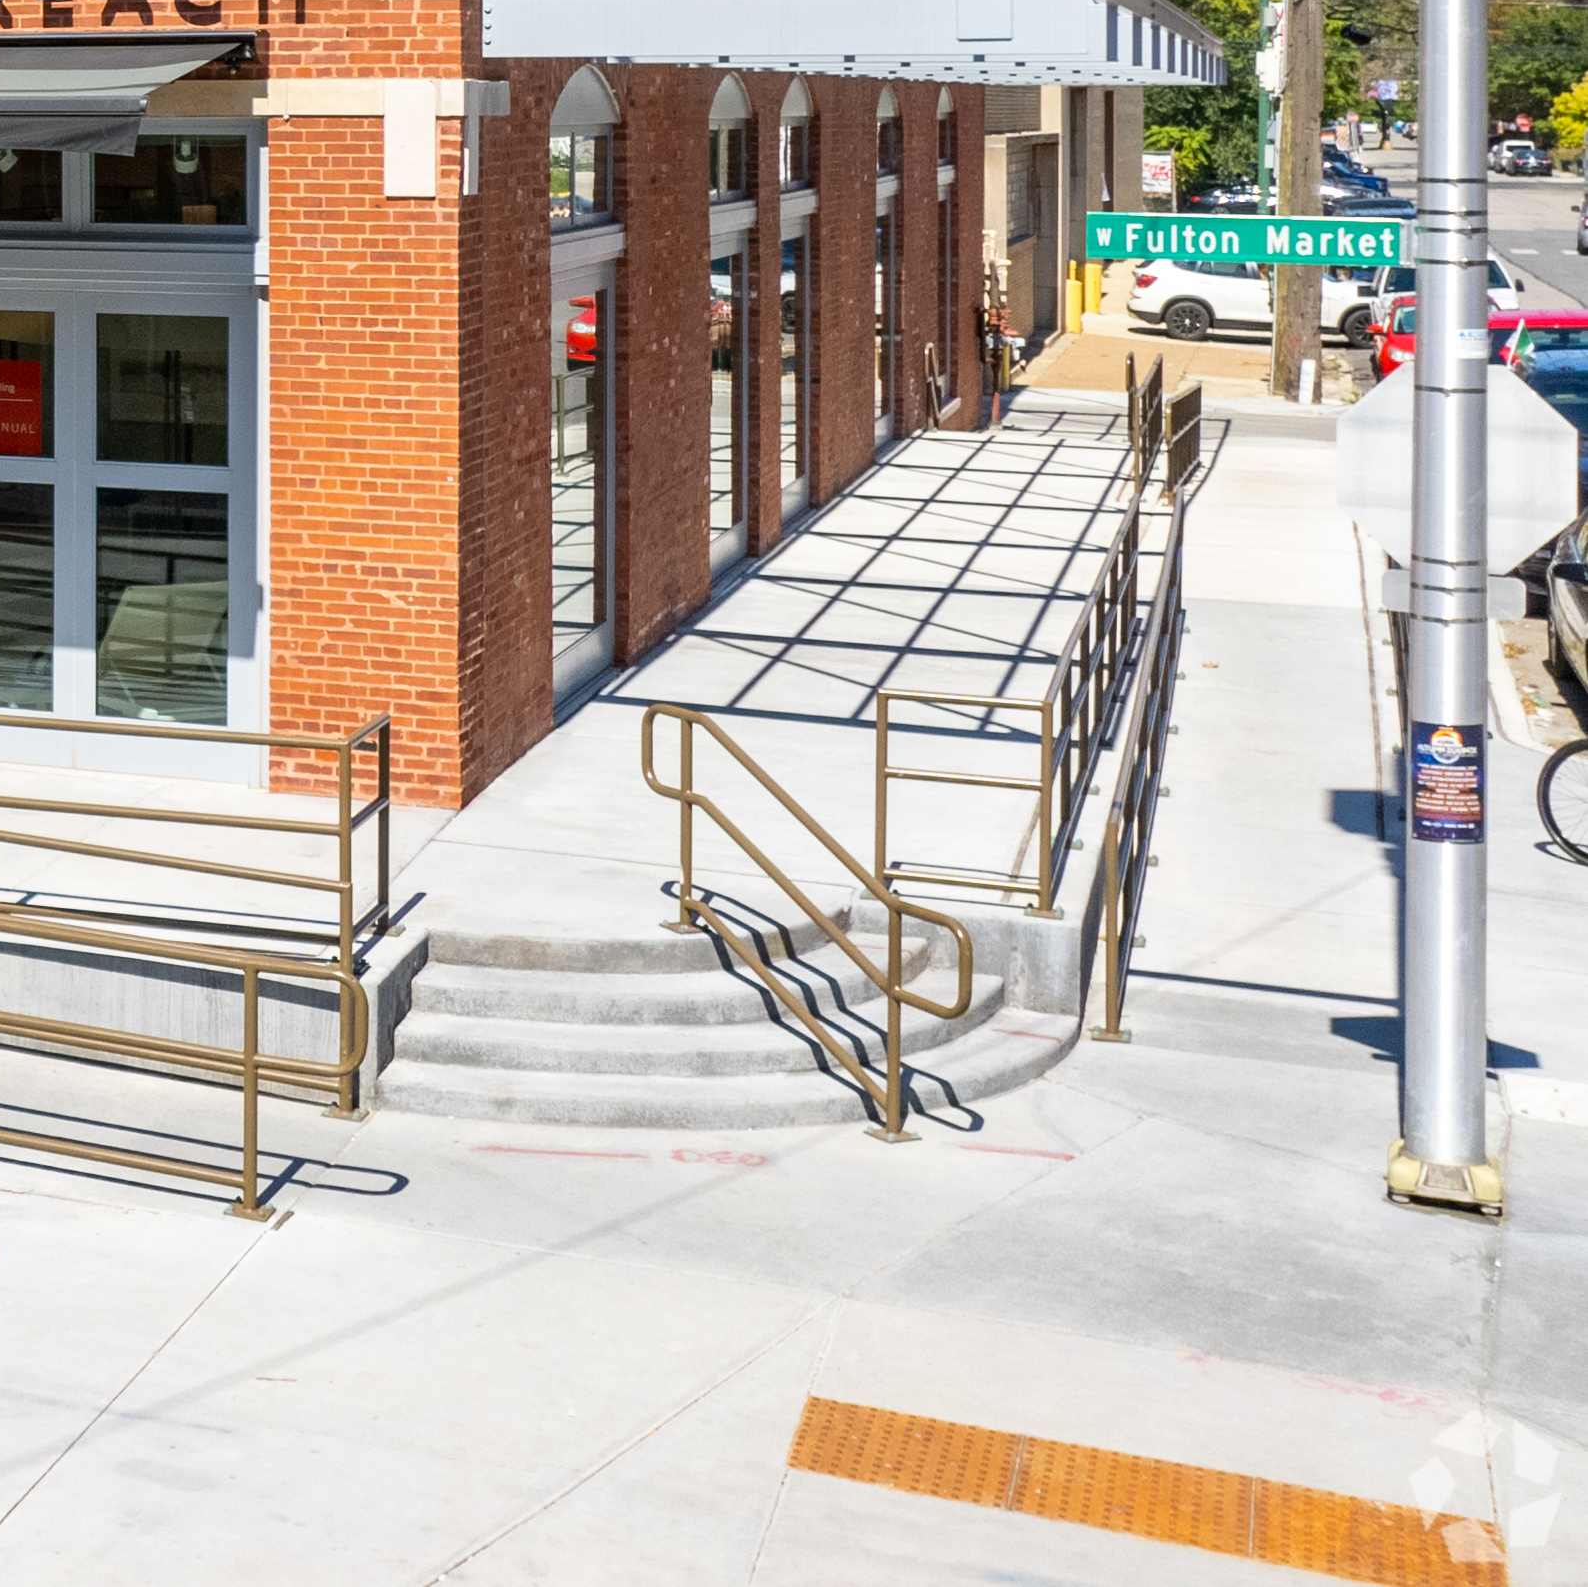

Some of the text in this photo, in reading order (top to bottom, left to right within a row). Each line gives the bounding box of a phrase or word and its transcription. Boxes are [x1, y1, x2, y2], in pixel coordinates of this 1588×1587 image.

[1096, 223, 1395, 258] W Fulton Market
